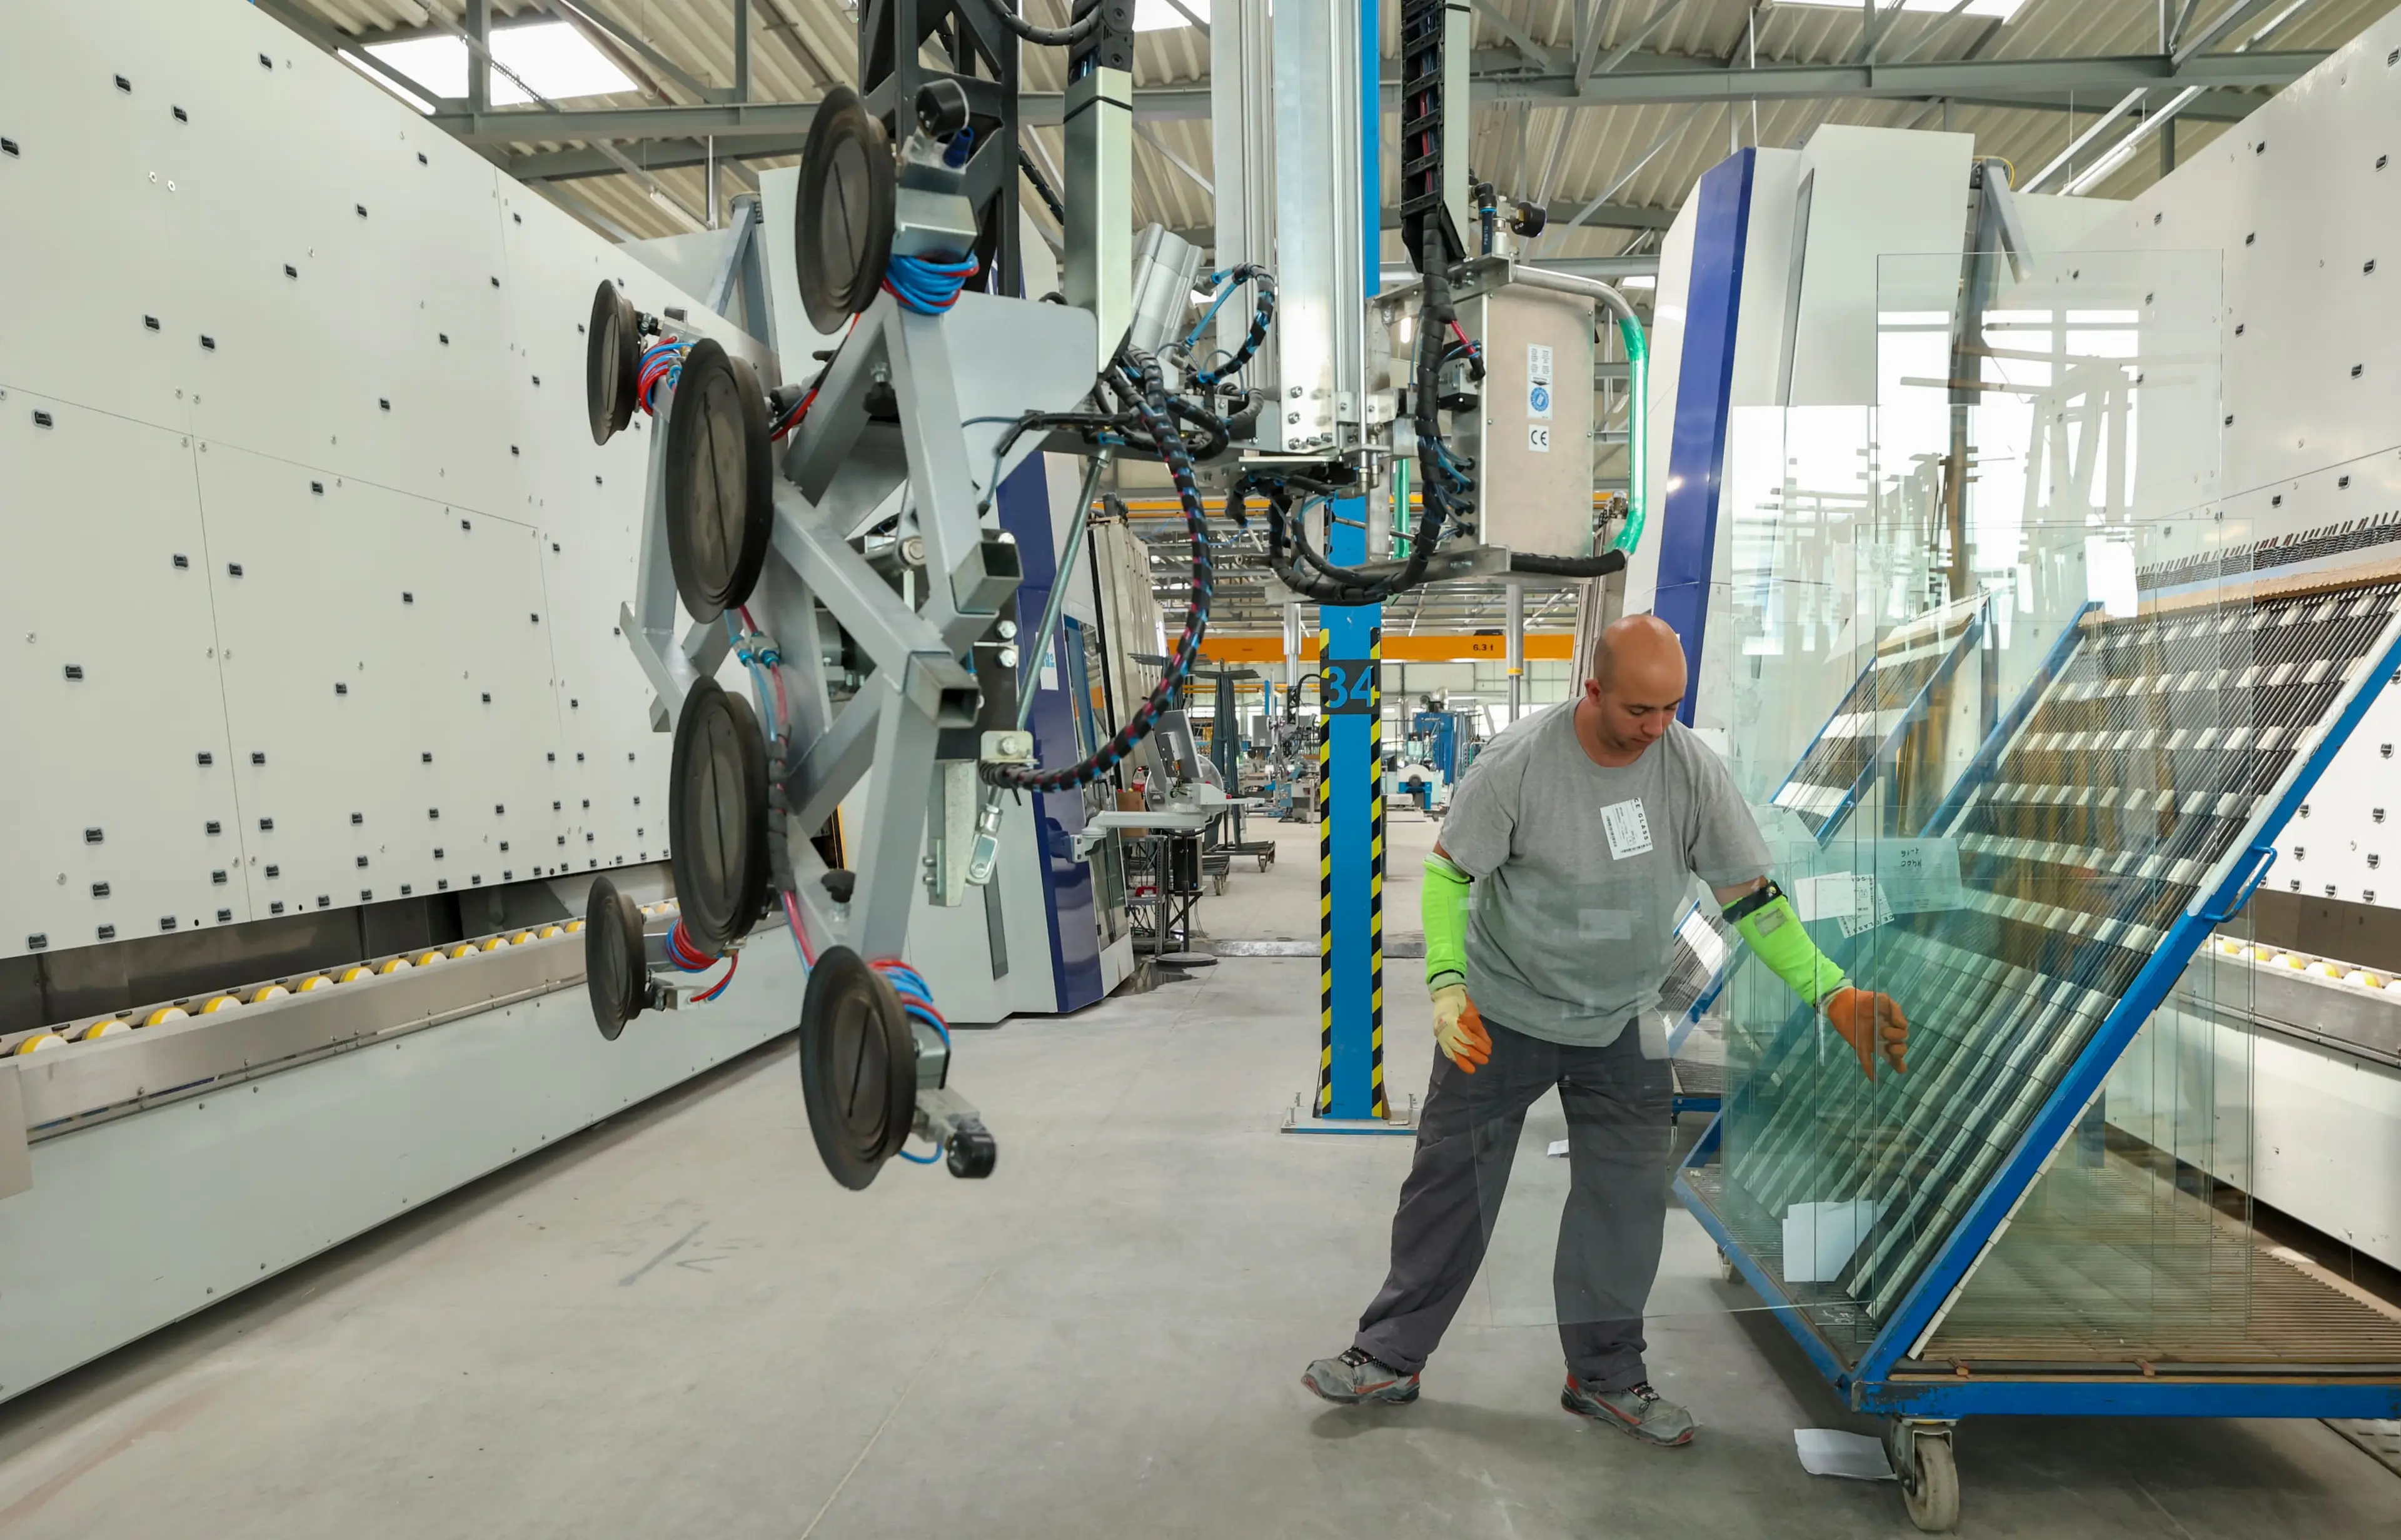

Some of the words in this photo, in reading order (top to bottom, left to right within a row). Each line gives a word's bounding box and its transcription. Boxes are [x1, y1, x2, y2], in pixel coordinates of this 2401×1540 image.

[1531, 430, 1547, 446] CE
[1472, 643, 1487, 652] 6.3
[1490, 643, 1494, 652] t
[1321, 665, 1381, 708] 34
[1638, 813, 1649, 840] GLASS
